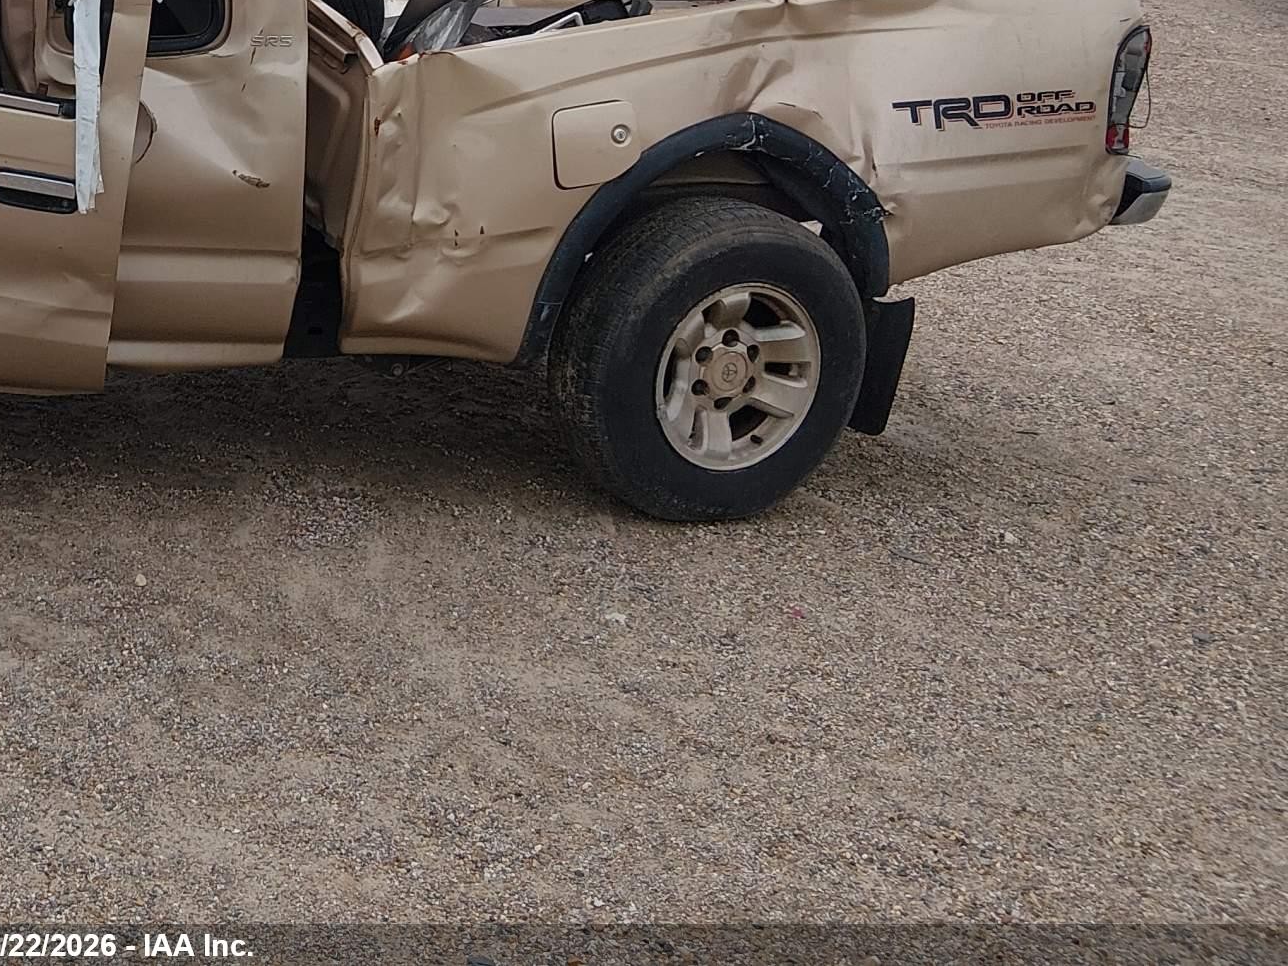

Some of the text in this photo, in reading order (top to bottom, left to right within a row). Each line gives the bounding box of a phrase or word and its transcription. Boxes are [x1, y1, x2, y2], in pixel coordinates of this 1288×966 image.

[1016, 89, 1076, 104] OFF
[892, 94, 1014, 131] TRD
[1016, 101, 1096, 119] ROAD
[984, 115, 1096, 130] TOYOTA RACING DEVELOPMENT
